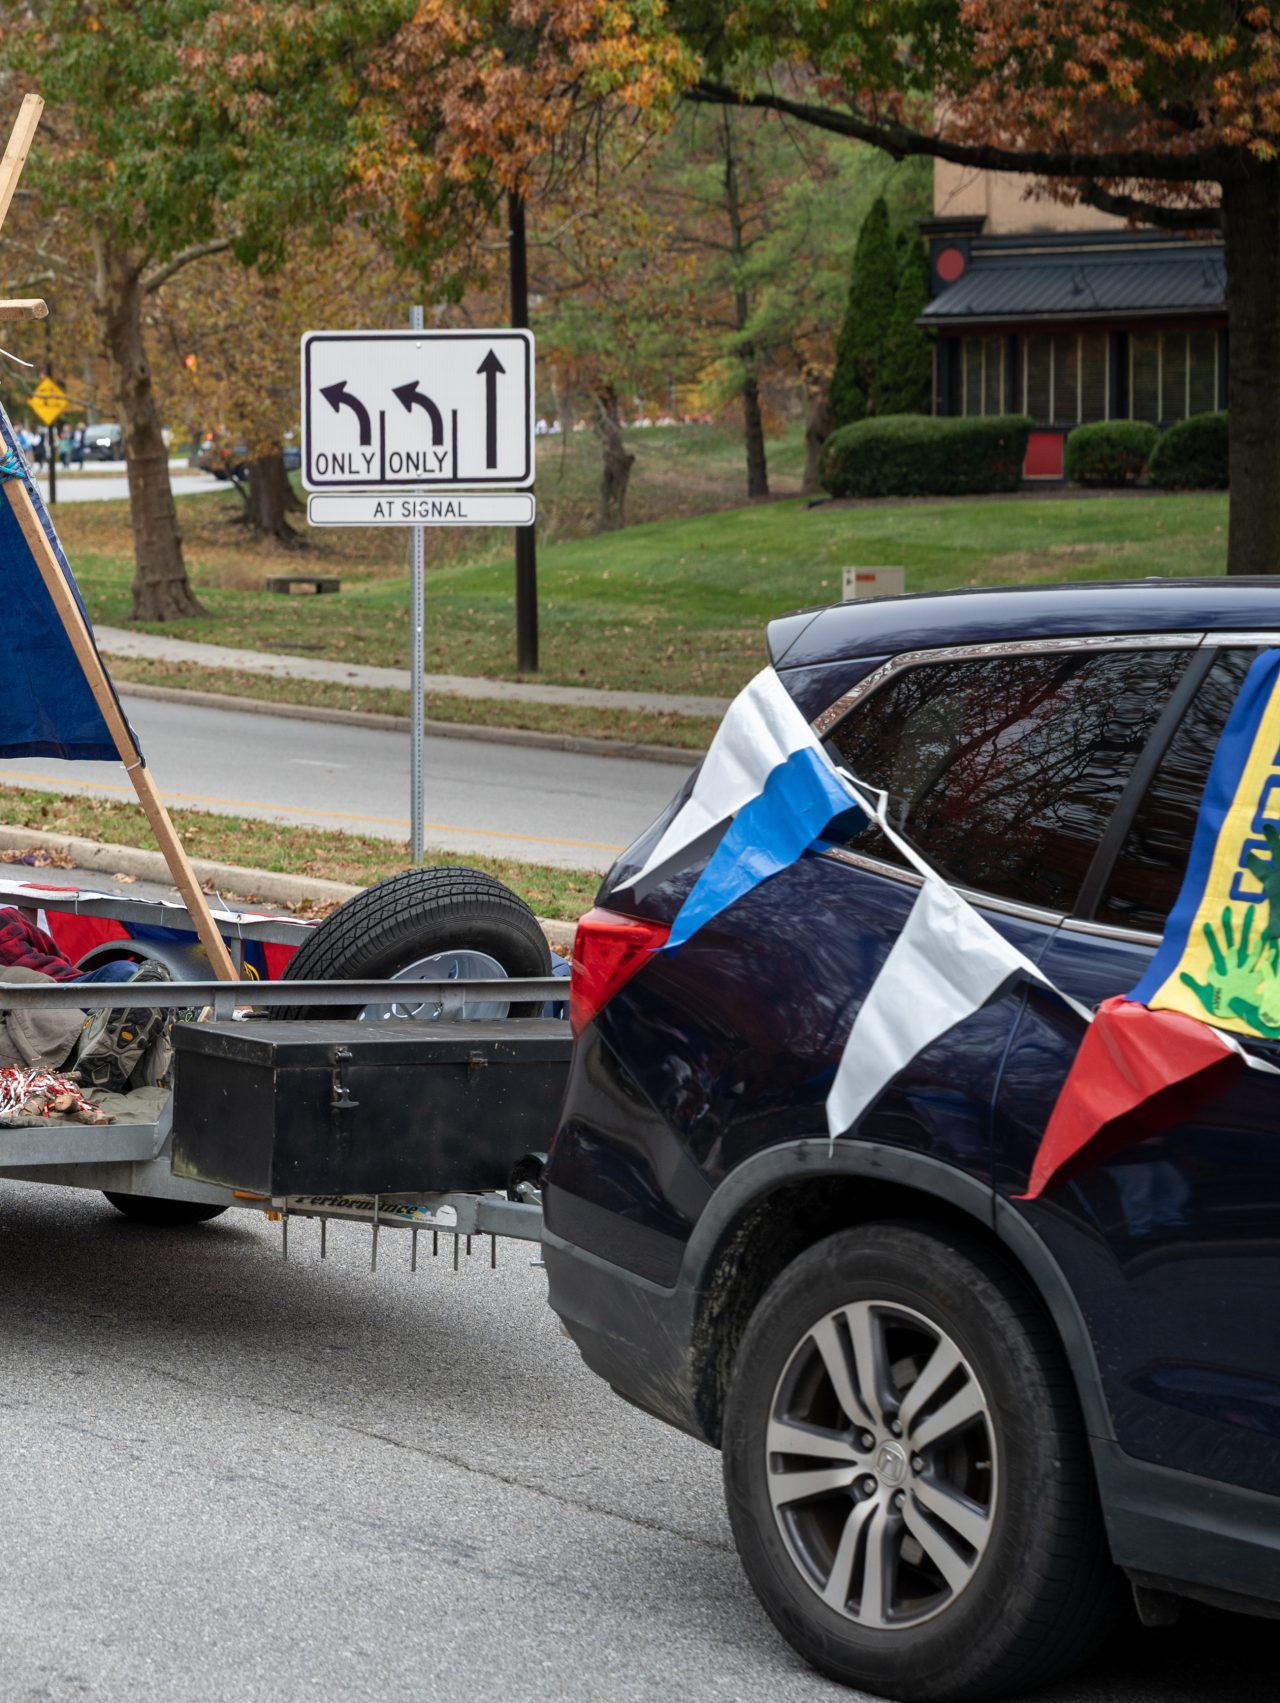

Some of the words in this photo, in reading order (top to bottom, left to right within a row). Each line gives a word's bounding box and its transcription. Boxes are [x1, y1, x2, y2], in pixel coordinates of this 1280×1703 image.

[316, 452, 375, 475] ONLY
[389, 451, 448, 473] ONLY
[373, 501, 395, 518] AT
[401, 501, 468, 518] SIGNAL
